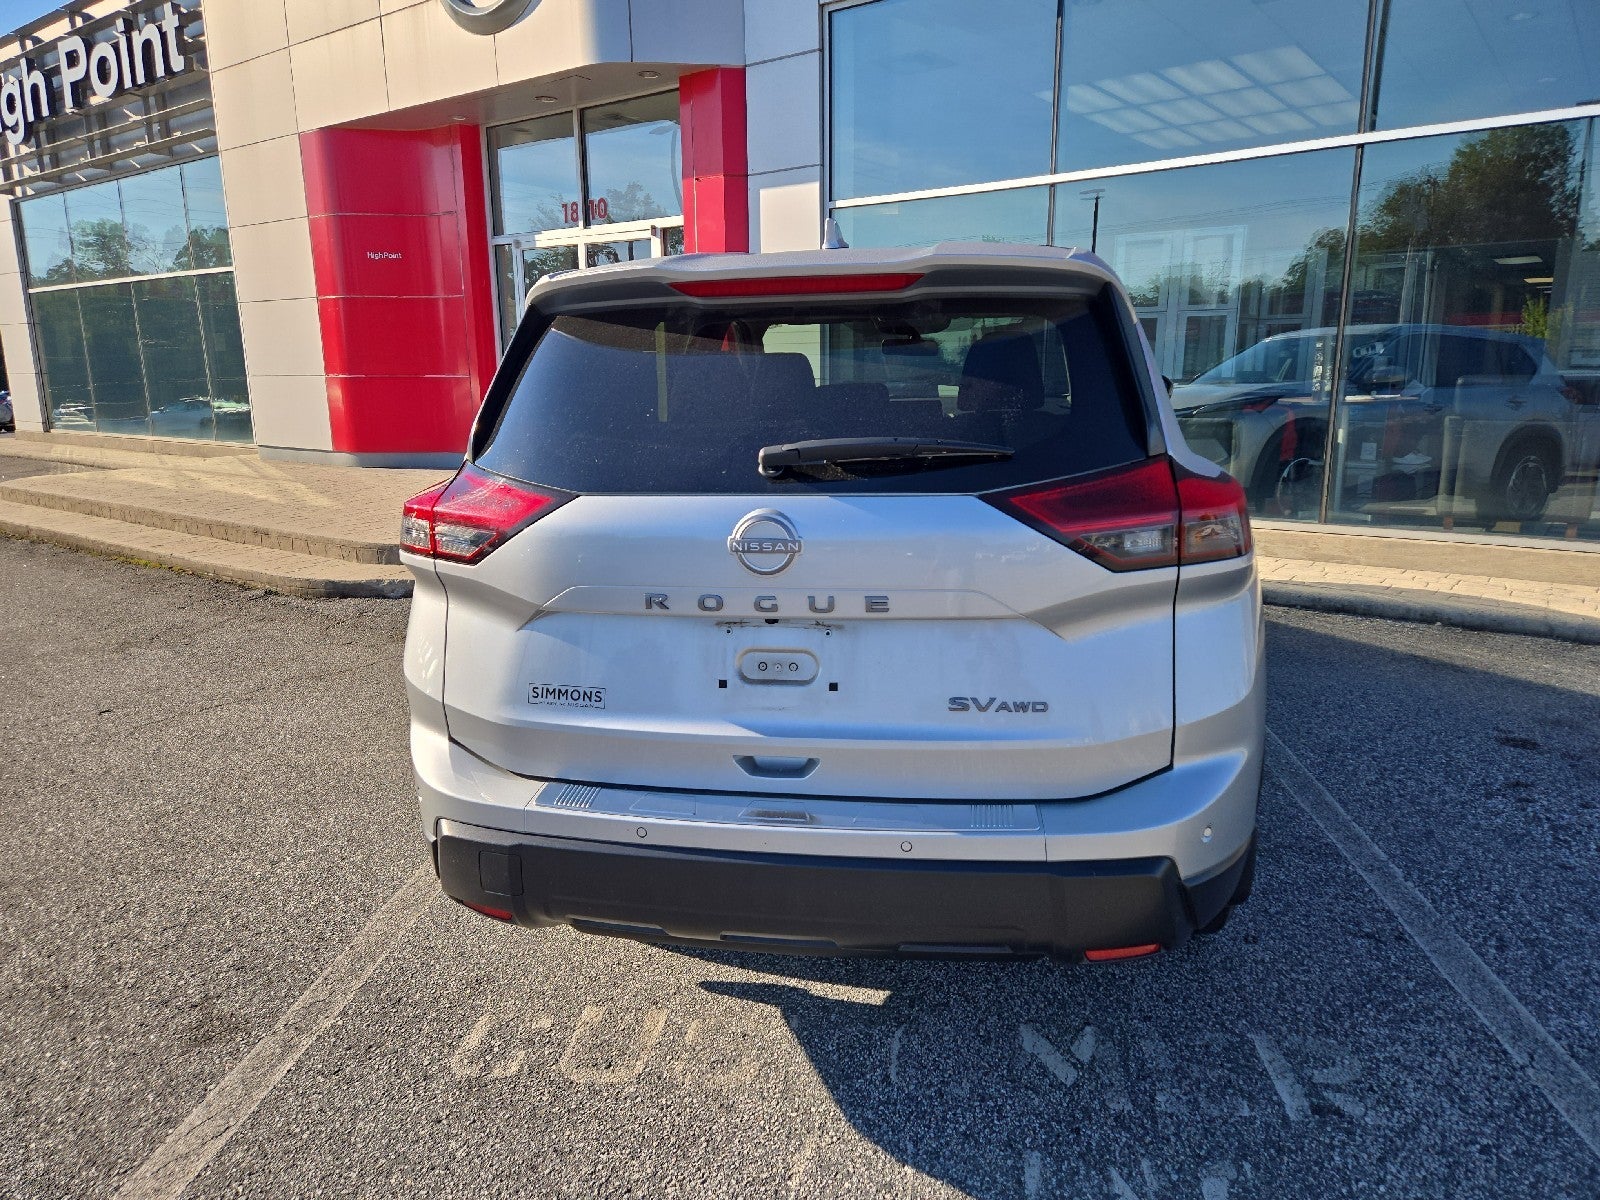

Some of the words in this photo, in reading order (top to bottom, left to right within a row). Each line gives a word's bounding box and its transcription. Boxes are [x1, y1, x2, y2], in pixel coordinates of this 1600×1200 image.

[0, 57, 50, 146] gh
[58, 2, 185, 110] Point
[561, 197, 608, 223] 1810
[367, 251, 384, 260] High
[383, 251, 402, 259] Point
[732, 540, 800, 551] NISSAN
[644, 592, 890, 614] ROGUE
[531, 686, 603, 703] SIMMONS
[948, 696, 997, 713] SV
[995, 701, 1049, 713] AWD
